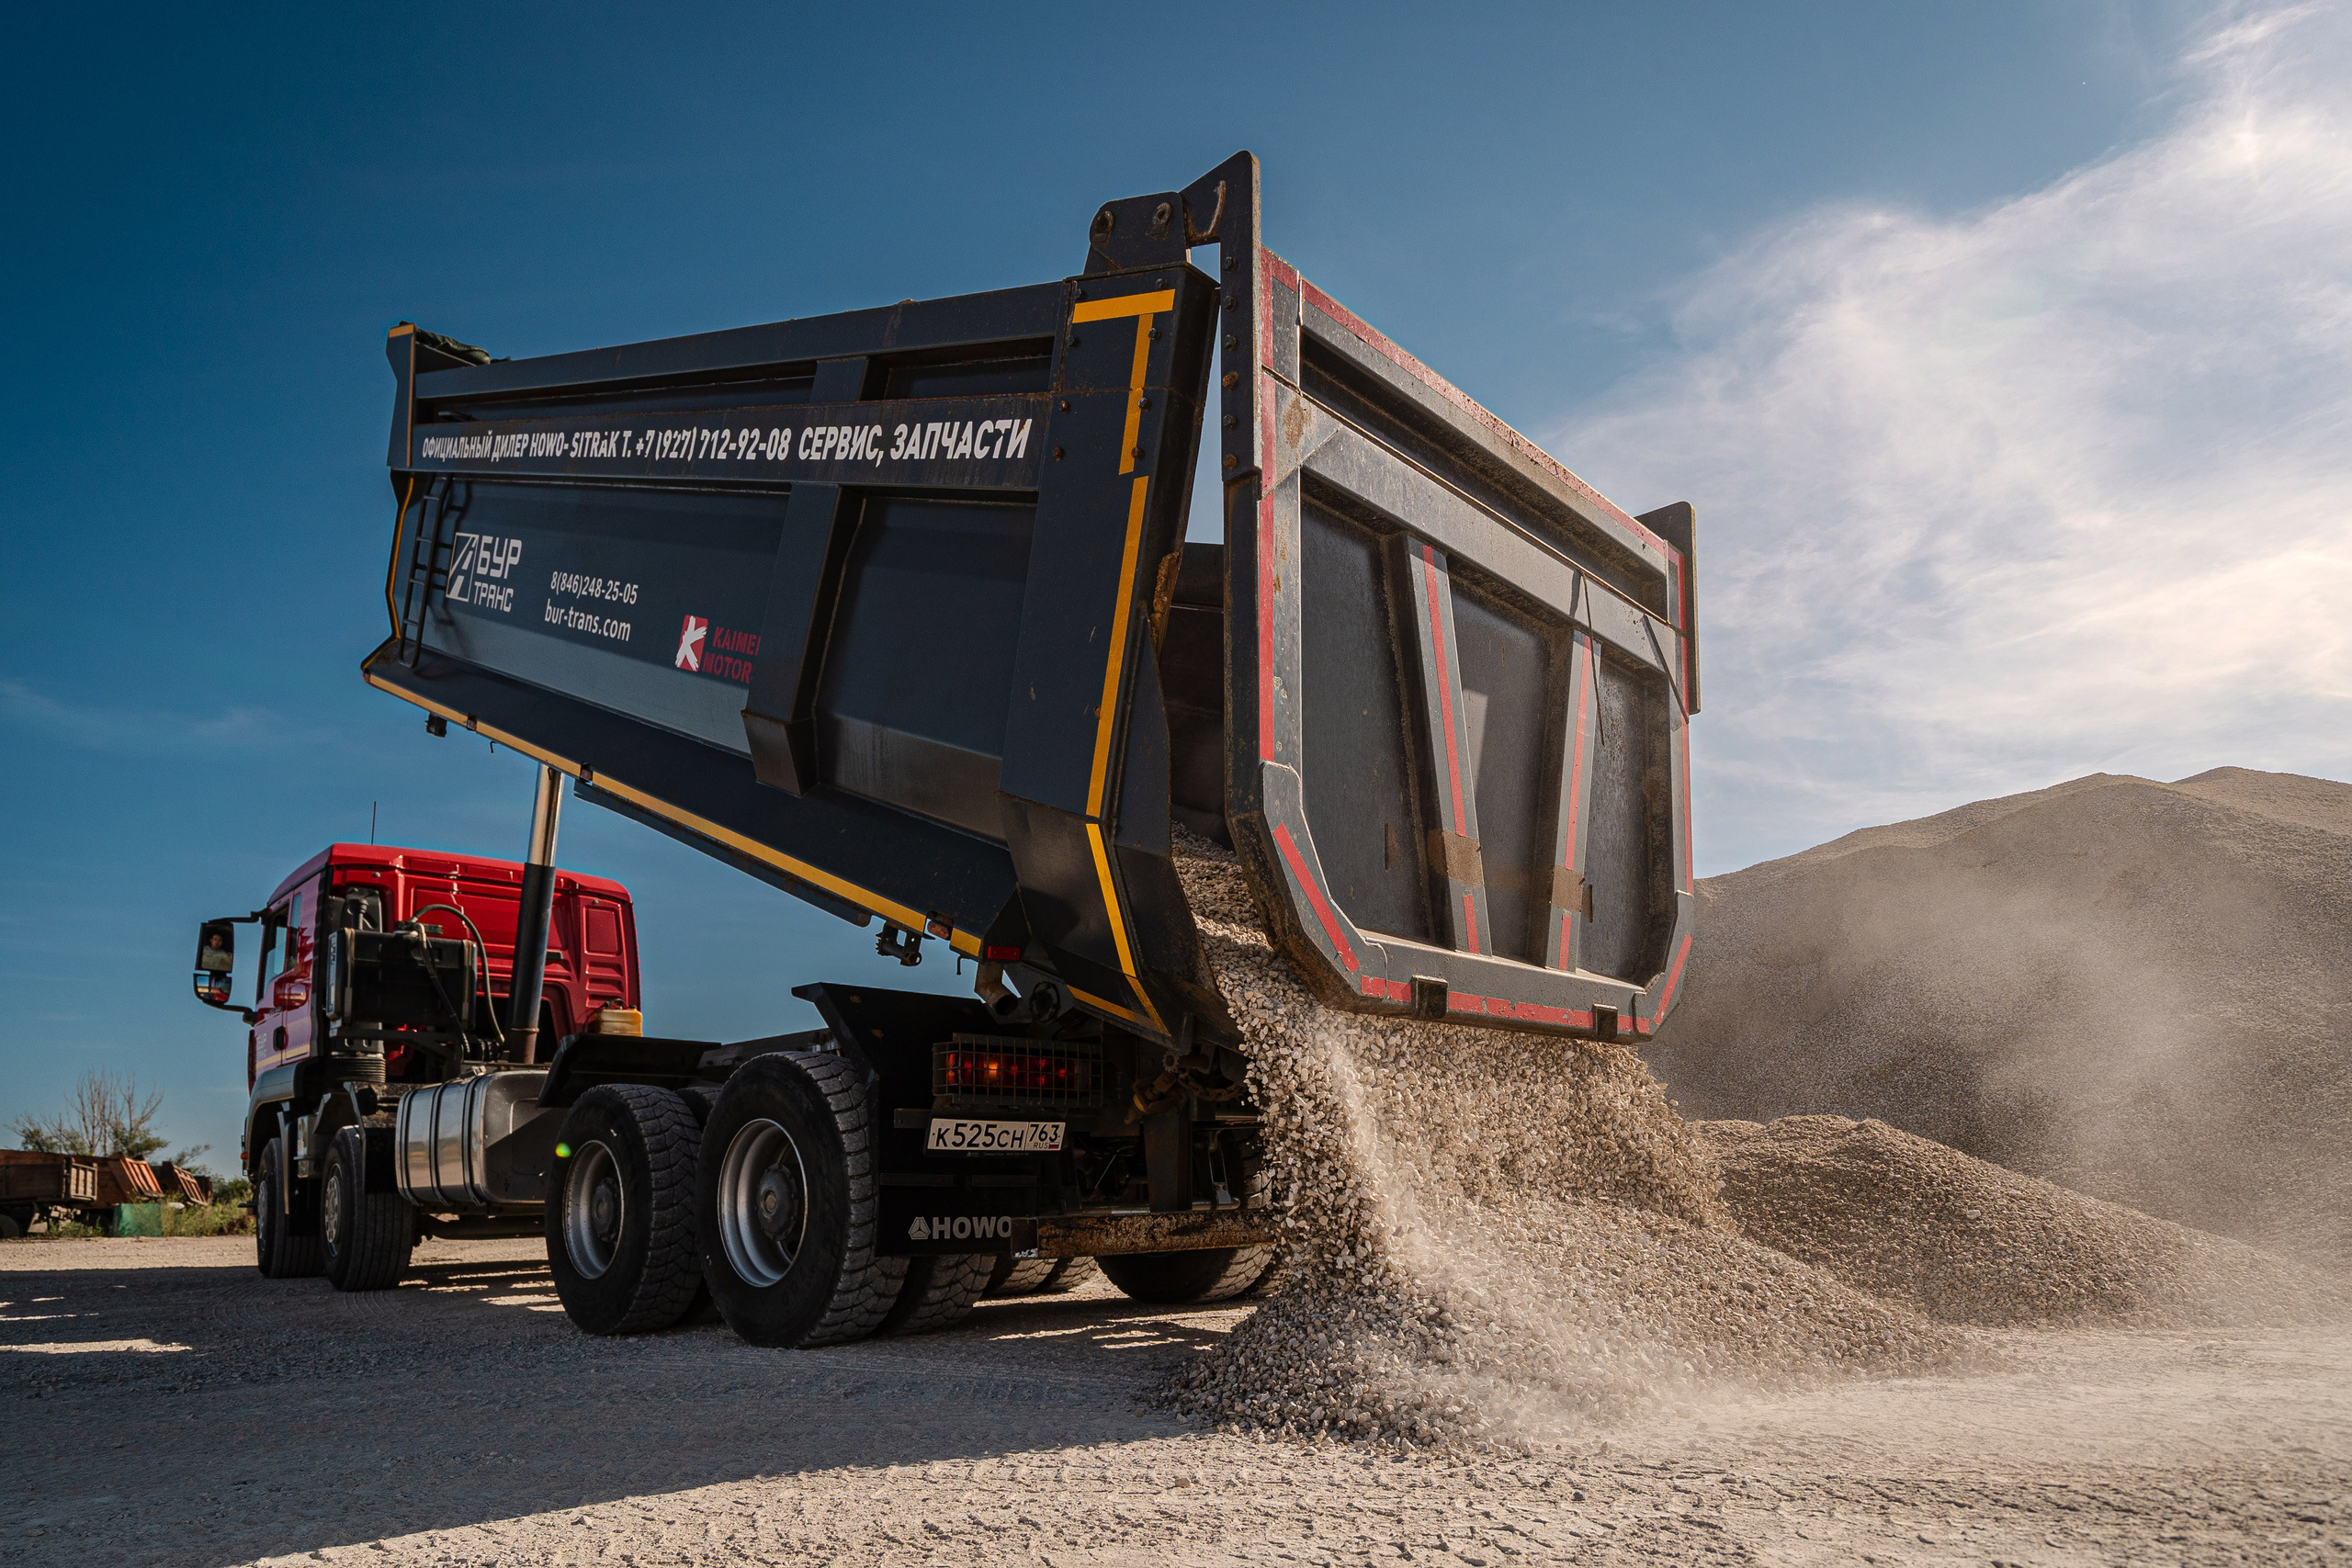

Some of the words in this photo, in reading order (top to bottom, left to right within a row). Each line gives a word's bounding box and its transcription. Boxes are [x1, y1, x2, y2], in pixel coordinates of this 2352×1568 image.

[422, 430, 492, 462] ОФИЦИАЛЬНЫЙ
[491, 434, 528, 462] ДИЛЕР
[656, 426, 696, 462] (927)
[698, 428, 792, 460] 712-92-08
[797, 424, 883, 468] СЕРВИС,
[890, 419, 1033, 460] ЗАПЧАСТИ
[477, 536, 522, 580] БУР
[474, 581, 514, 613] ТРАНС
[550, 571, 639, 605] 8(846)248-25-05
[545, 599, 630, 641] bur-trans.com
[702, 651, 752, 684] MOTOR
[1029, 1123, 1060, 1142] 763
[933, 1216, 1011, 1239] HOWO
